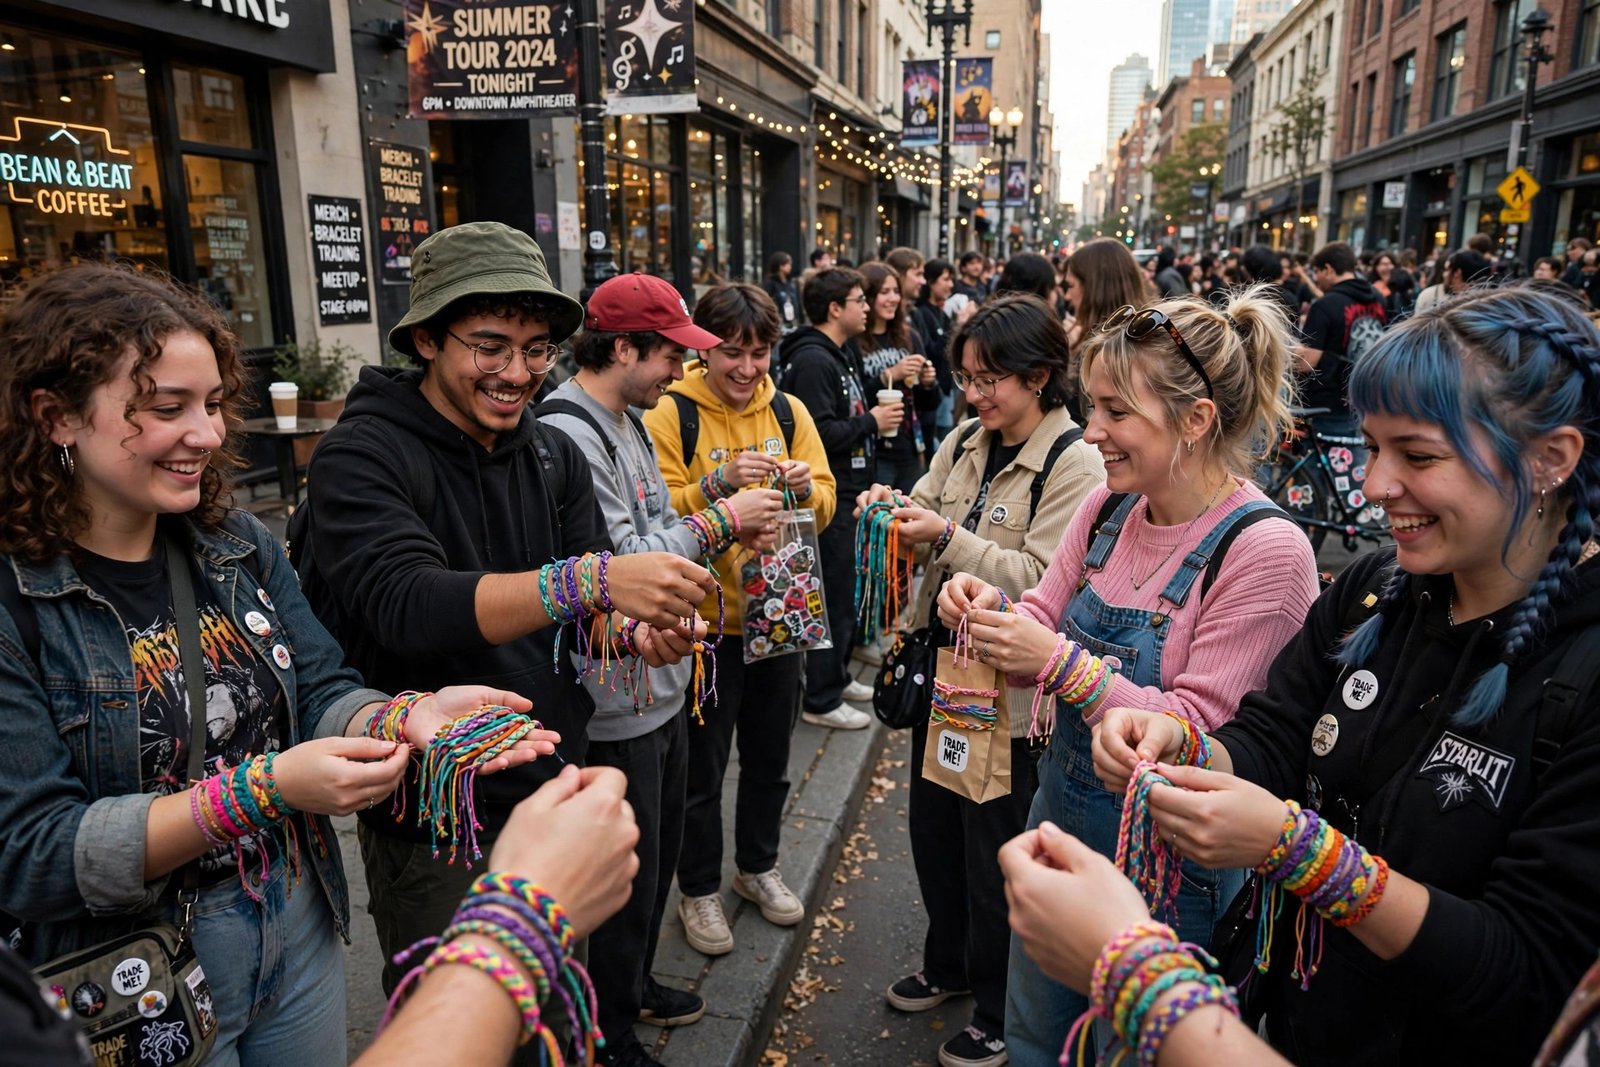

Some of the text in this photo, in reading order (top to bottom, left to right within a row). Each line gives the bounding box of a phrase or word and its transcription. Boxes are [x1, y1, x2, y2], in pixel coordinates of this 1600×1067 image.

[453, 5, 551, 37] SUMMER
[443, 38, 557, 69] TOUR 2024
[467, 73, 536, 94] TONIGHT
[422, 93, 576, 110] 6PM DOWNTOWN AMPHITHEATER
[381, 148, 412, 167] MERCH
[0, 152, 133, 190] BEAN & BEAT
[380, 167, 423, 187] BRACELET
[37, 188, 113, 217] COFFEE
[383, 186, 420, 205] TRADING
[314, 204, 349, 222] MERCH
[314, 224, 361, 242] BRACELET
[317, 244, 360, 262] TRADING
[322, 271, 360, 288] MEETUP
[1352, 677, 1374, 694] TRADE
[943, 736, 966, 754] TRADE
[943, 748, 961, 766] ME!
[1430, 738, 1509, 790] STARLIT
[117, 963, 144, 982] TRADE
[122, 975, 142, 991] ME!
[90, 1033, 128, 1058] TRADE
